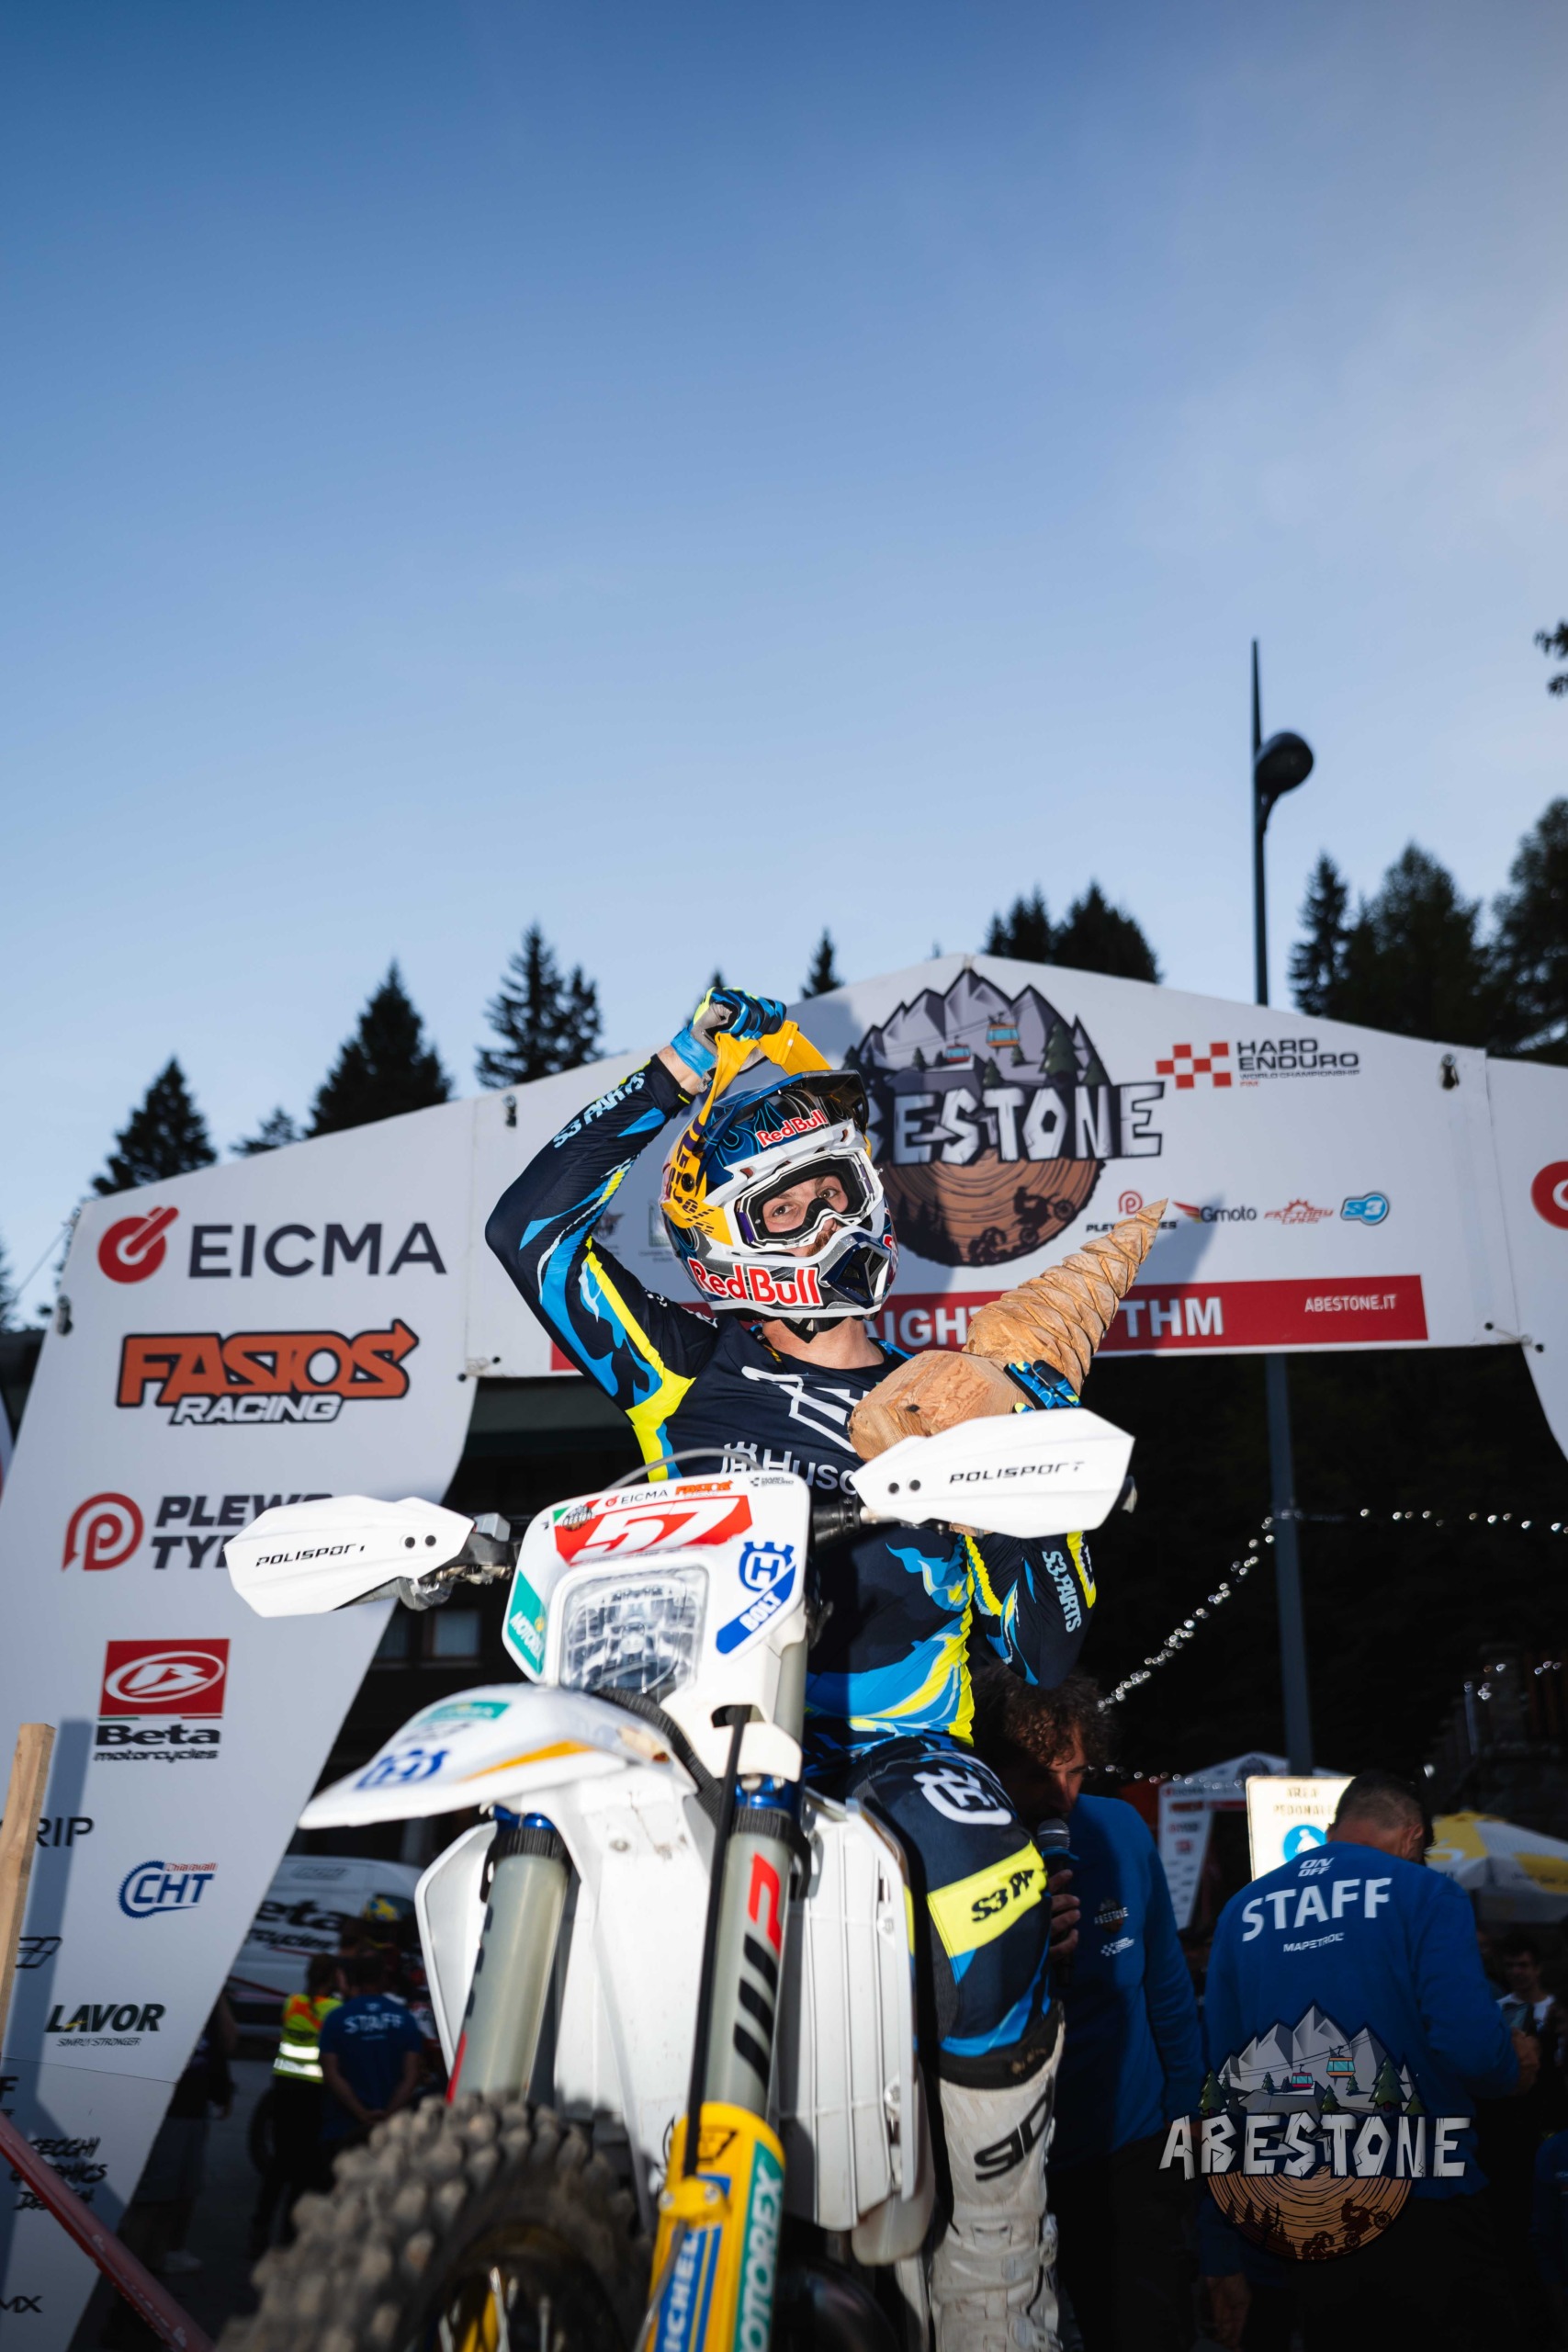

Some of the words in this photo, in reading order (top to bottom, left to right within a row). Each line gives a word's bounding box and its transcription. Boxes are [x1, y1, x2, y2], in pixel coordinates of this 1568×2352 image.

[1237, 1039, 1318, 1056] HARD
[1238, 1053, 1359, 1071] ENDURO
[188, 1222, 447, 1278] EICMA
[688, 1257, 749, 1299] Red
[747, 1268, 823, 1306] Bull
[1304, 1295, 1396, 1312] ABESTONE.IT
[173, 1394, 343, 1423] RACING
[621, 1491, 669, 1505] EICMA
[562, 1497, 740, 1562] 57
[739, 1591, 782, 1632] BOLT
[96, 1723, 220, 1746] Beta
[1297, 1866, 1331, 1877] OFF
[1299, 1857, 1335, 1869] ON
[132, 1873, 213, 1904] CHT
[1242, 1877, 1393, 1941] STAFF
[45, 2004, 165, 2032] LAVOR
